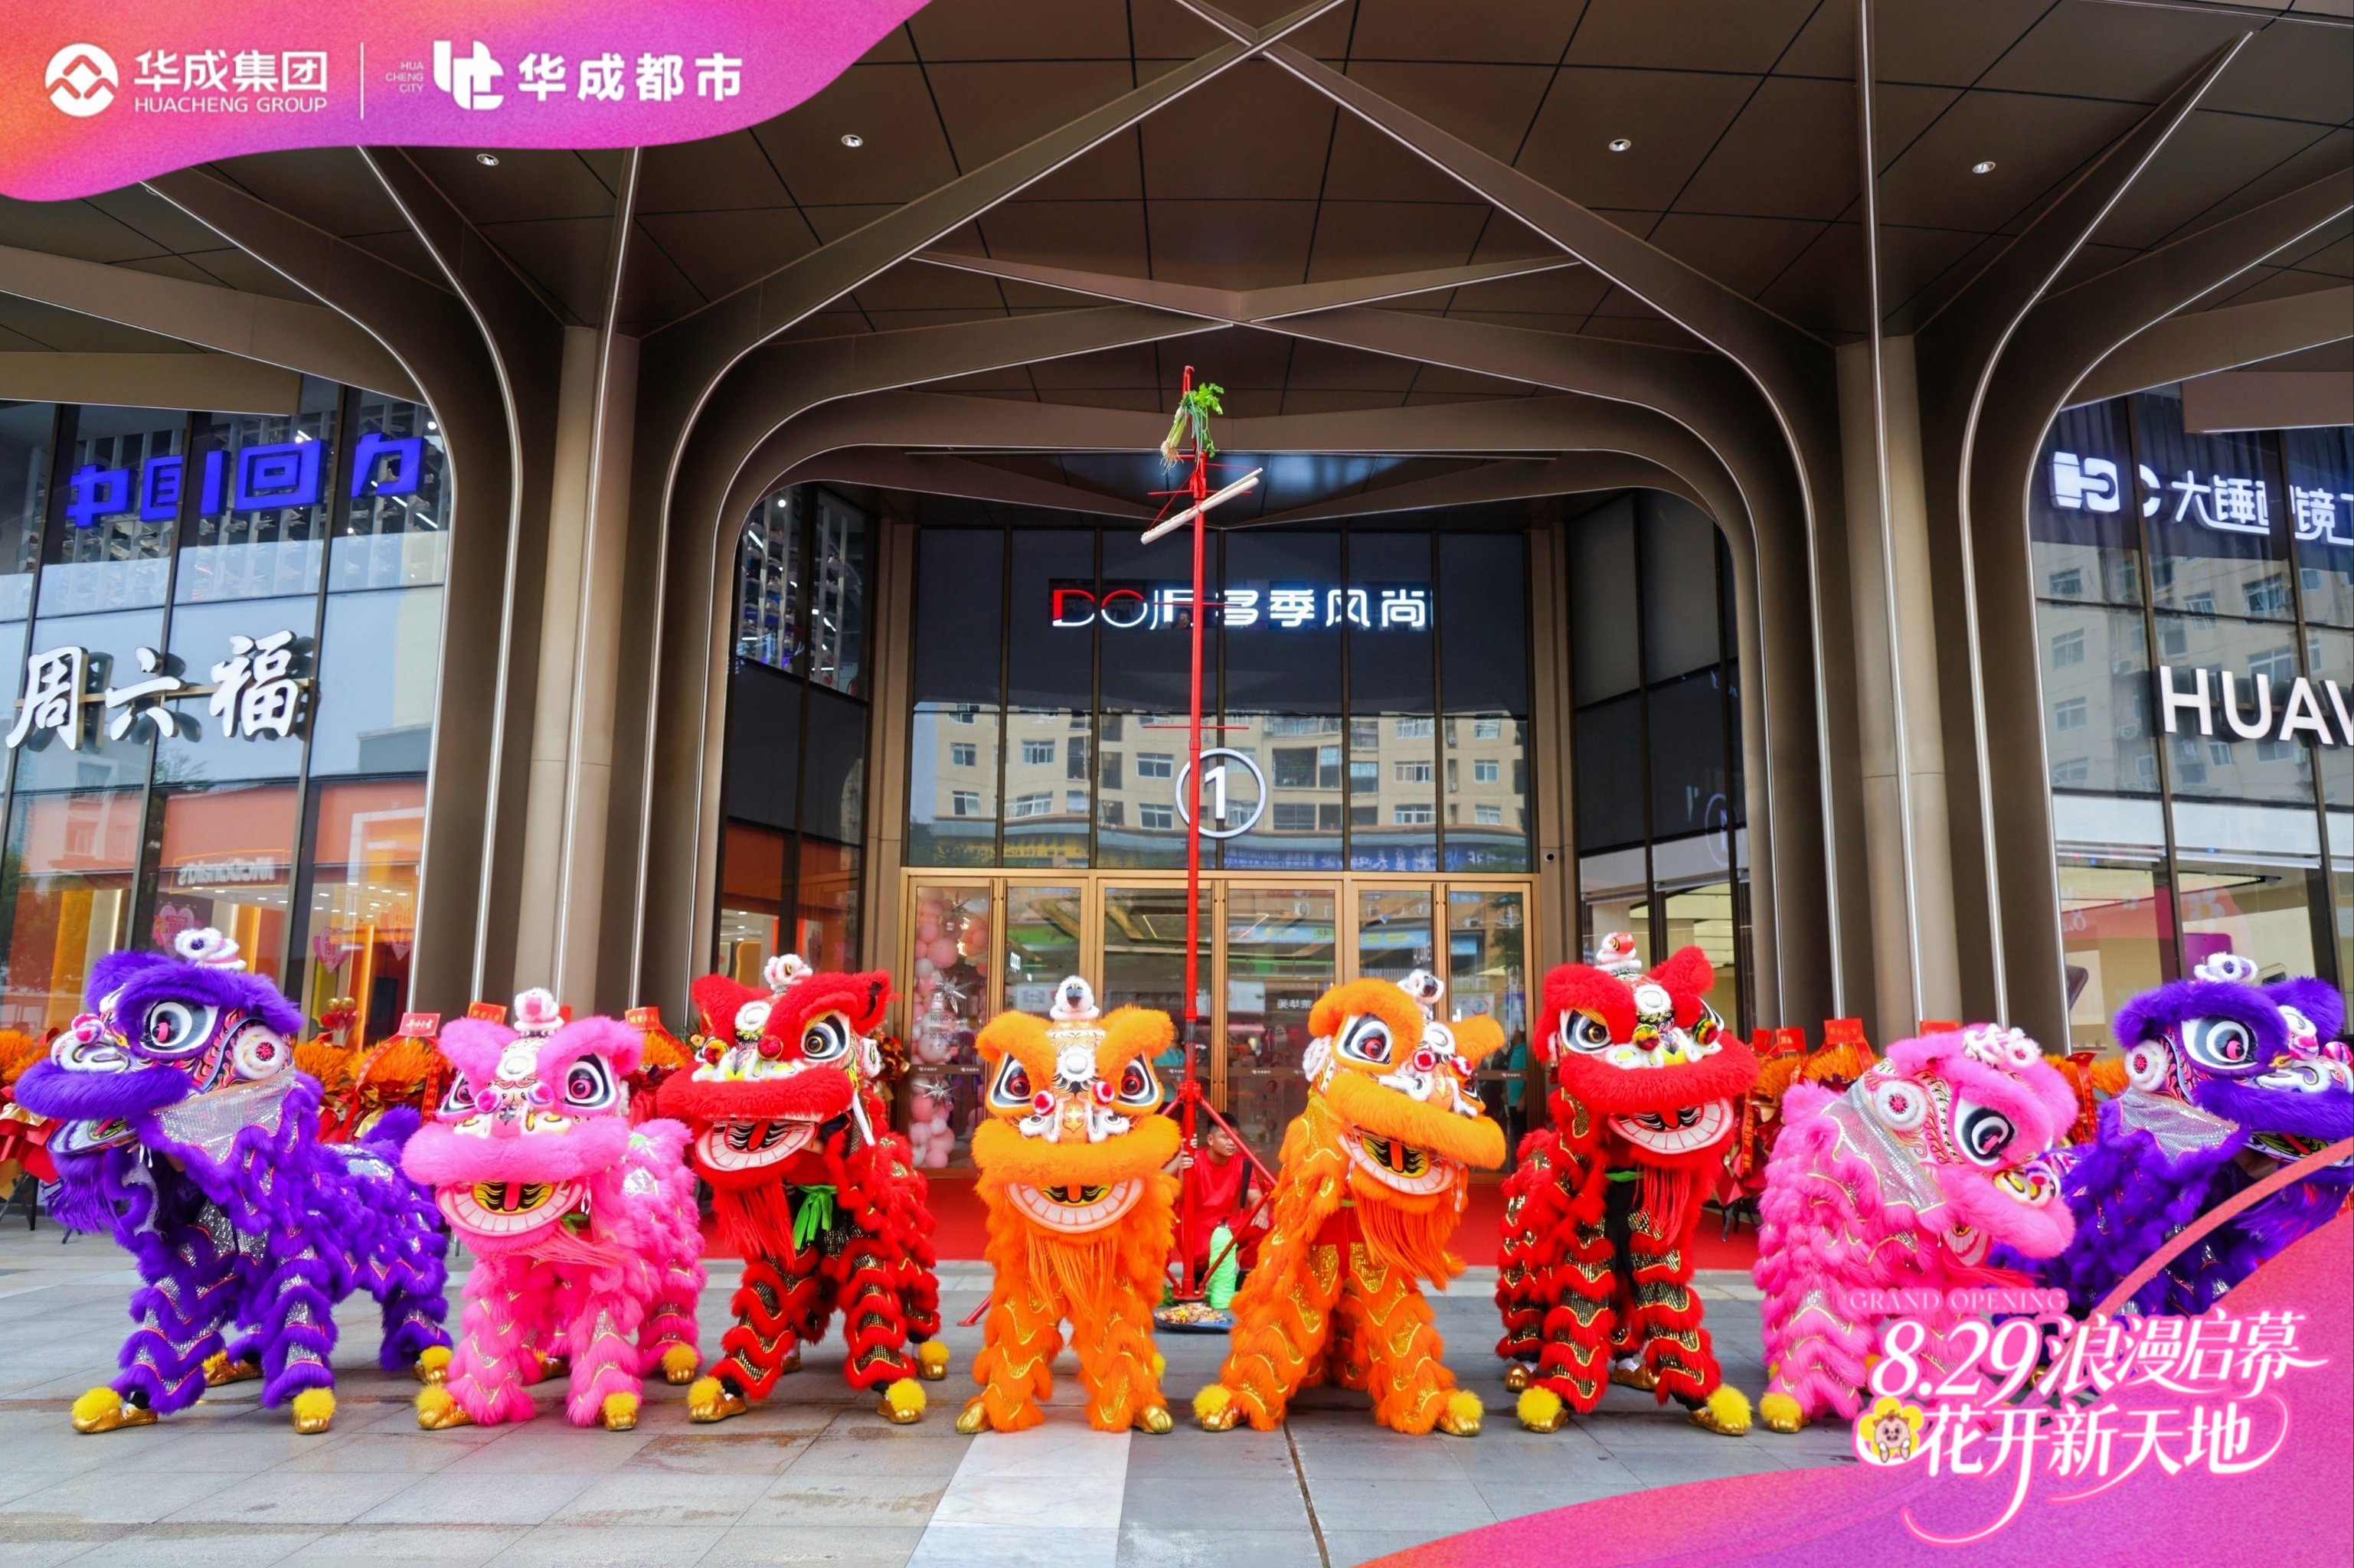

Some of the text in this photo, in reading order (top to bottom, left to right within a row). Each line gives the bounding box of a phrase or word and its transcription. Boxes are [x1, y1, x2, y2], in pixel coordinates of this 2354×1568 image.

[1215, 589, 1427, 627] 多季风尚
[6, 629, 299, 750] 周六福
